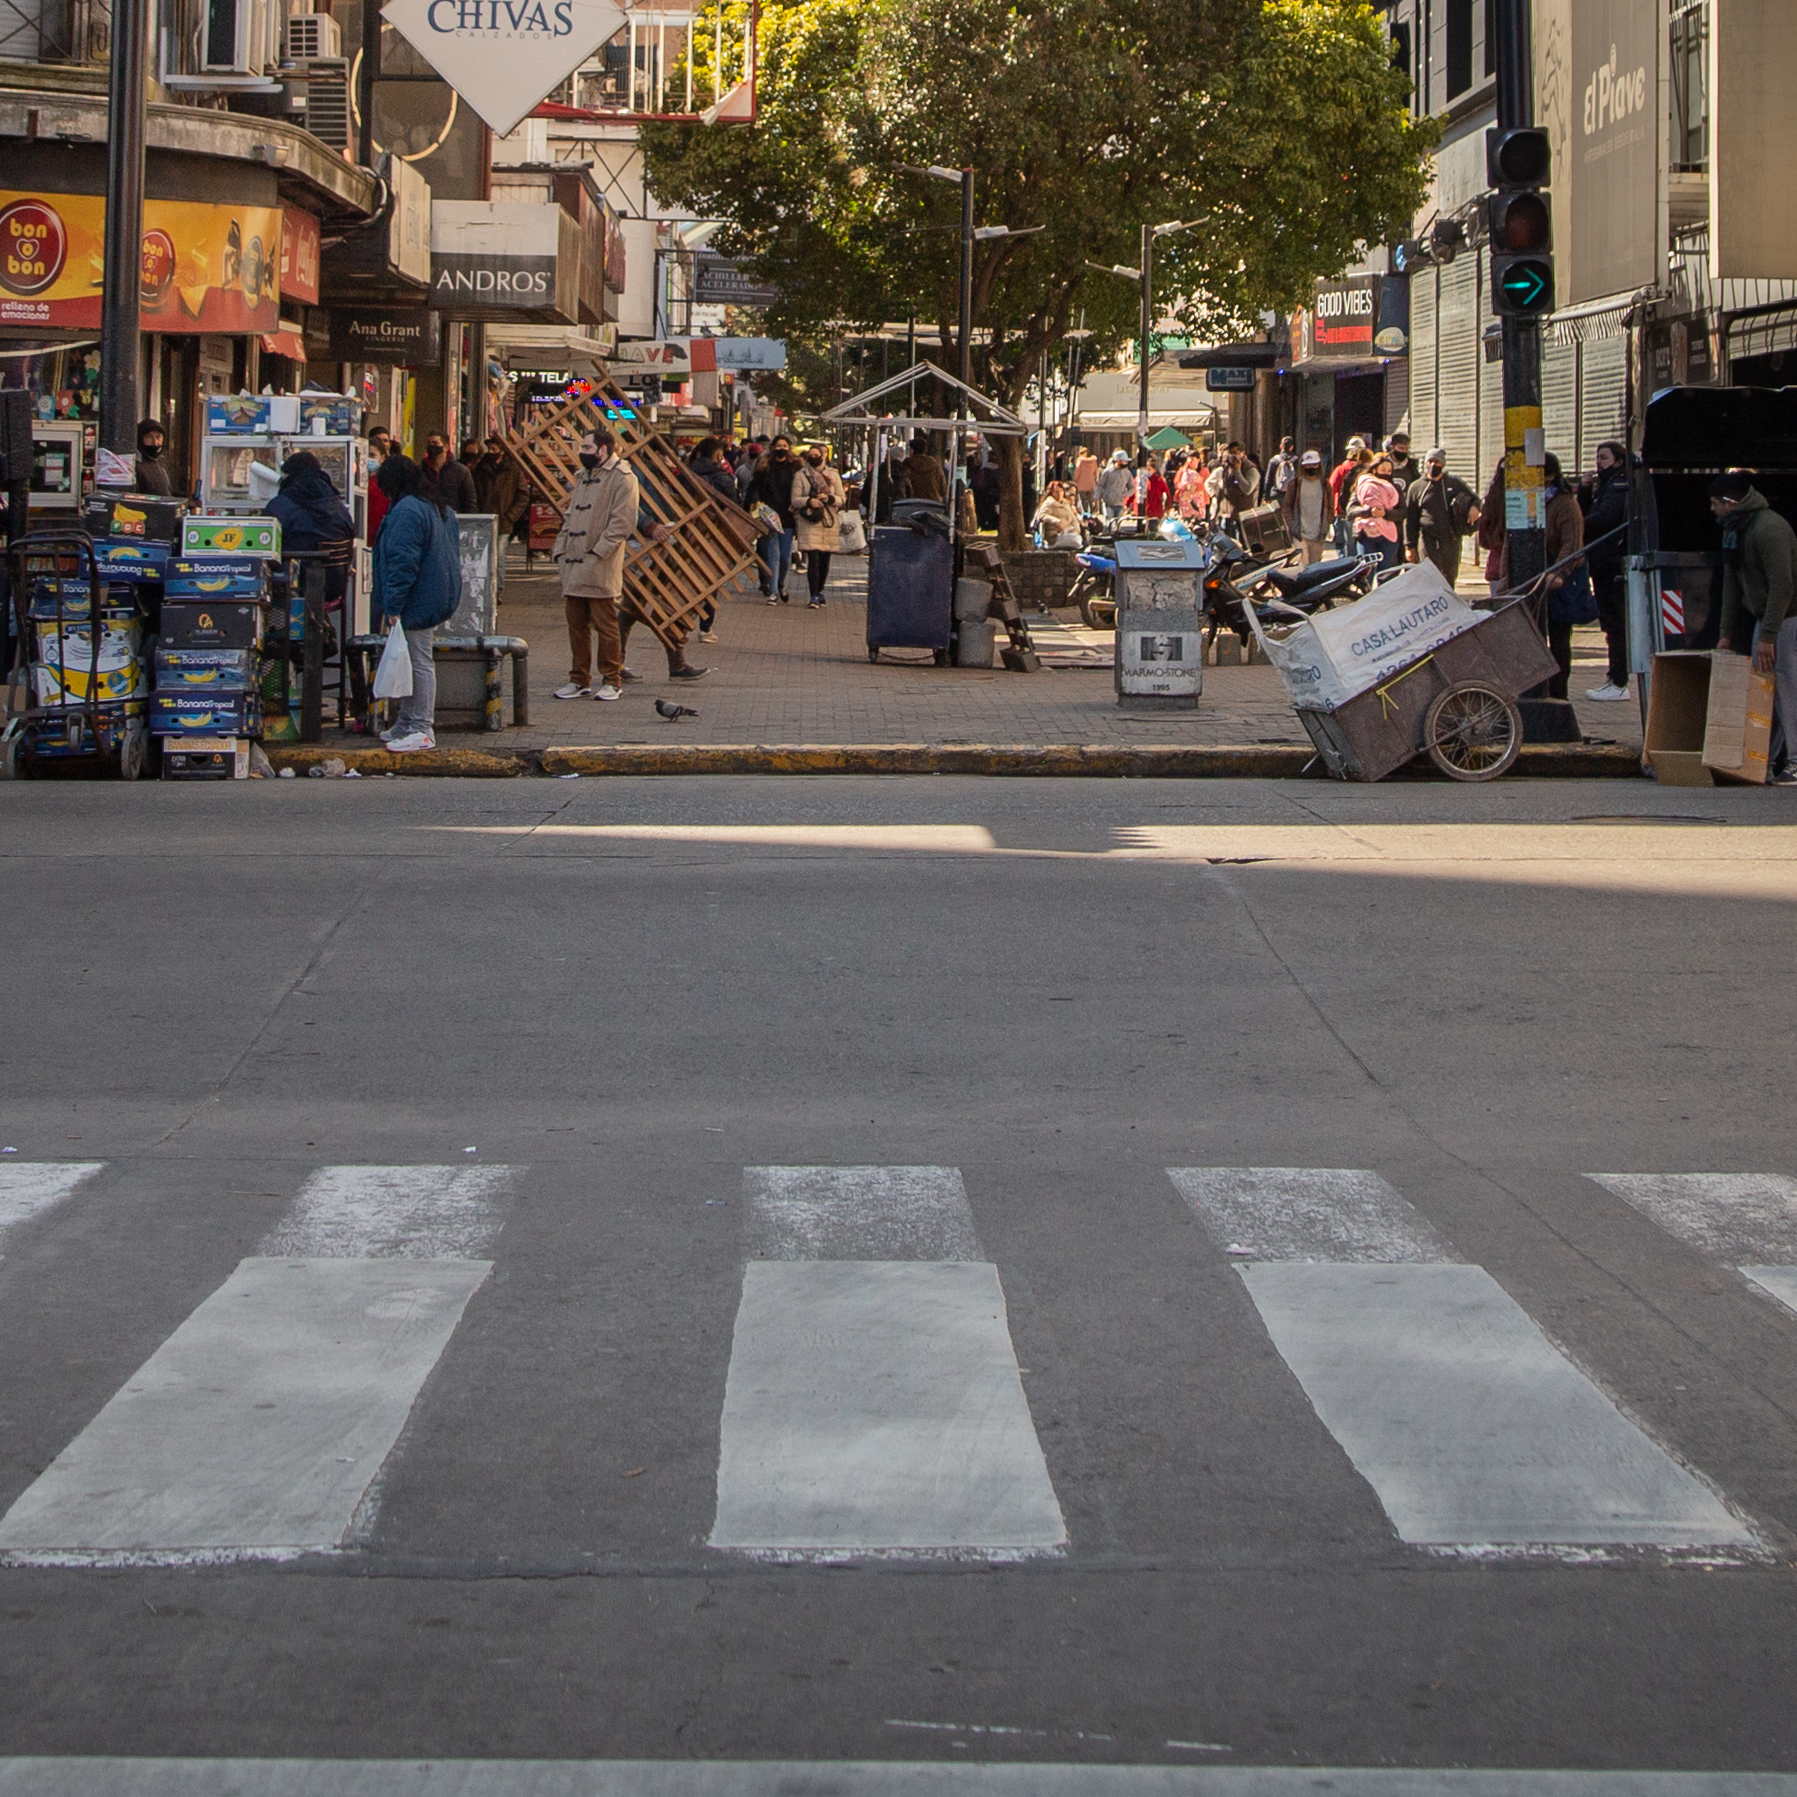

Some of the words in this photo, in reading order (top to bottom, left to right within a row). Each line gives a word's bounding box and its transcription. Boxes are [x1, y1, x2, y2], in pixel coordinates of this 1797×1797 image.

[455, 29, 553, 41] CALZADOS
[1598, 46, 1646, 130] Piave
[9, 218, 48, 239] bon
[21, 243, 34, 257] o
[142, 239, 164, 258] bon
[7, 255, 46, 276] bon
[436, 268, 548, 293] ANDROS
[1, 302, 35, 312] relleno
[37, 302, 50, 312] de
[1317, 290, 1342, 318] GOOD
[1343, 288, 1373, 316] VIBES
[0, 311, 50, 321] emociones
[348, 320, 377, 335] Ana
[380, 320, 421, 337] Grant
[222, 533, 236, 543] JF
[1350, 628, 1392, 658] CASA
[1393, 595, 1449, 637] LAUTARO
[1152, 683, 1171, 692] 1995
[168, 740, 200, 751] BANANAS
